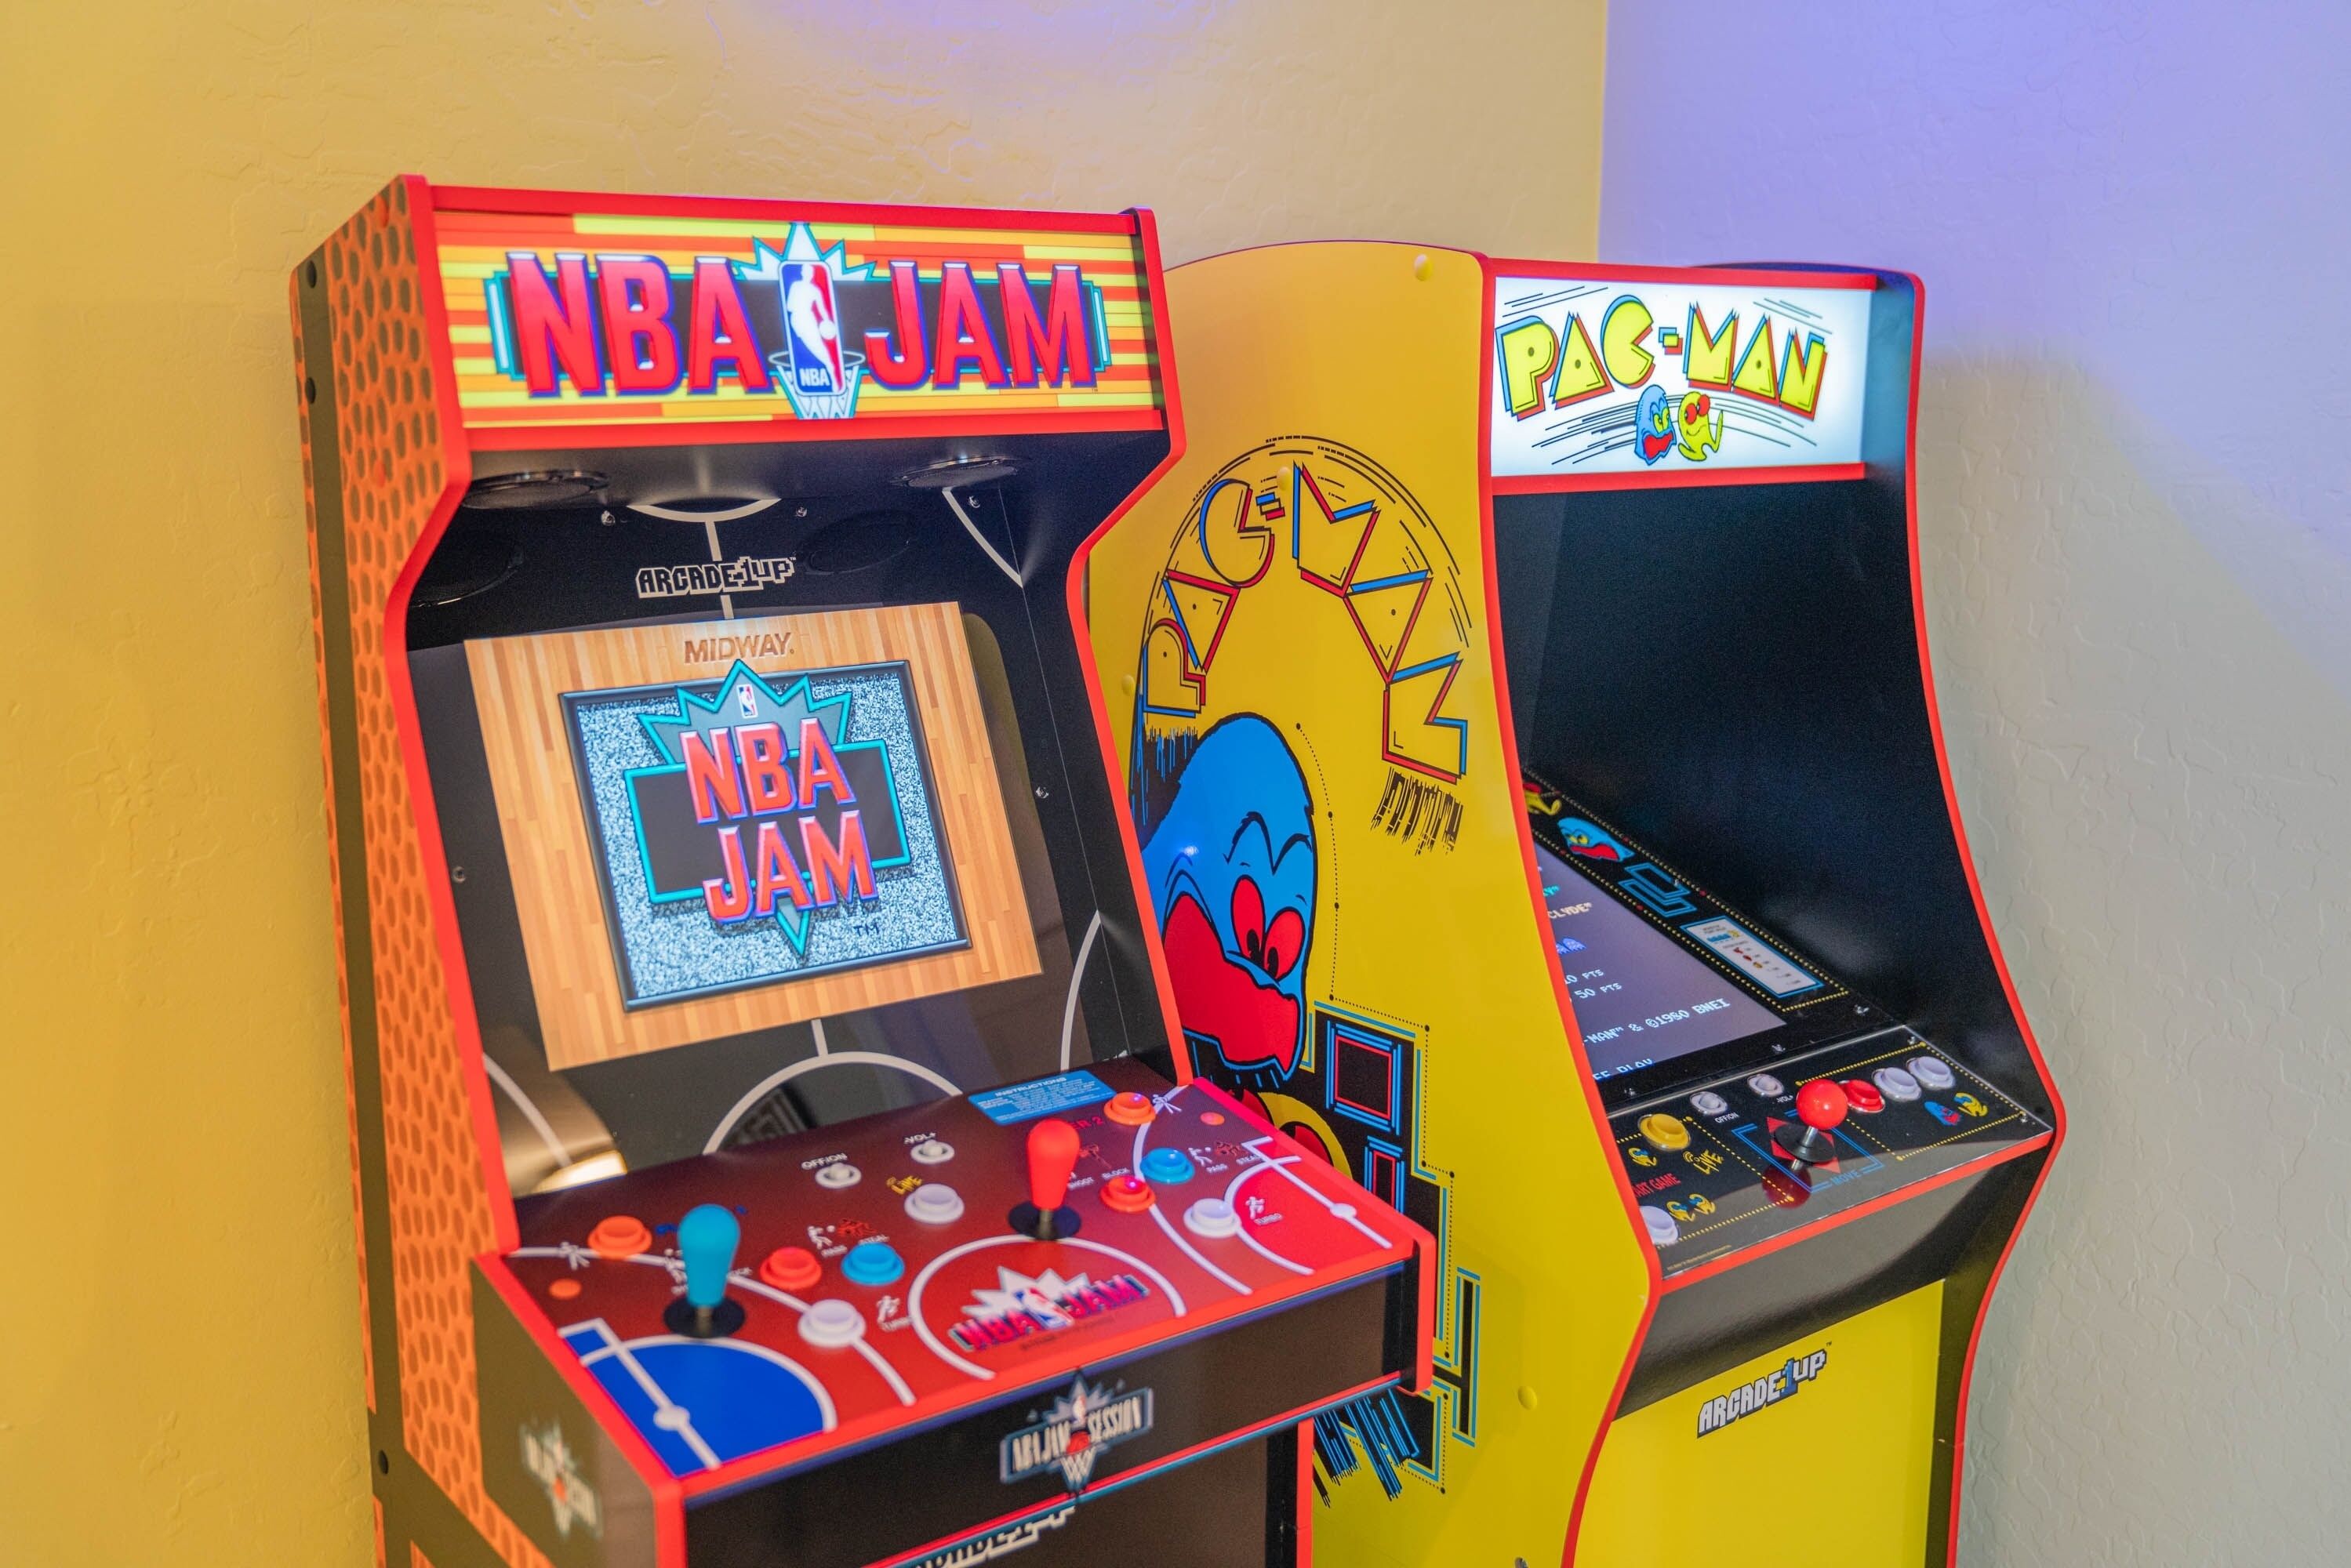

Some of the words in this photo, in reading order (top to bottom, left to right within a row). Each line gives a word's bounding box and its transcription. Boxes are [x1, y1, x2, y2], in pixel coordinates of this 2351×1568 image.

[506, 251, 776, 398] NBA
[864, 260, 1097, 390] JAM
[1495, 295, 1827, 421] PAC-MAN
[800, 368, 830, 387] NBA
[679, 717, 857, 824] NBA
[703, 810, 878, 924] JAM
[1574, 988, 1596, 999] 50
[1600, 982, 1622, 993] PTS
[1582, 969, 1604, 979] PTS
[1628, 1022, 1644, 1033] &
[1691, 998, 1731, 1014] BNEI
[994, 1076, 1067, 1097] INSTRUCTIONS
[801, 1152, 848, 1171] OFF/ON
[1102, 1167, 1129, 1180] BLOCK
[953, 1308, 1043, 1350] NBA
[1059, 1274, 1145, 1319] JAM
[1697, 1348, 1827, 1439] ARCADE1UP
